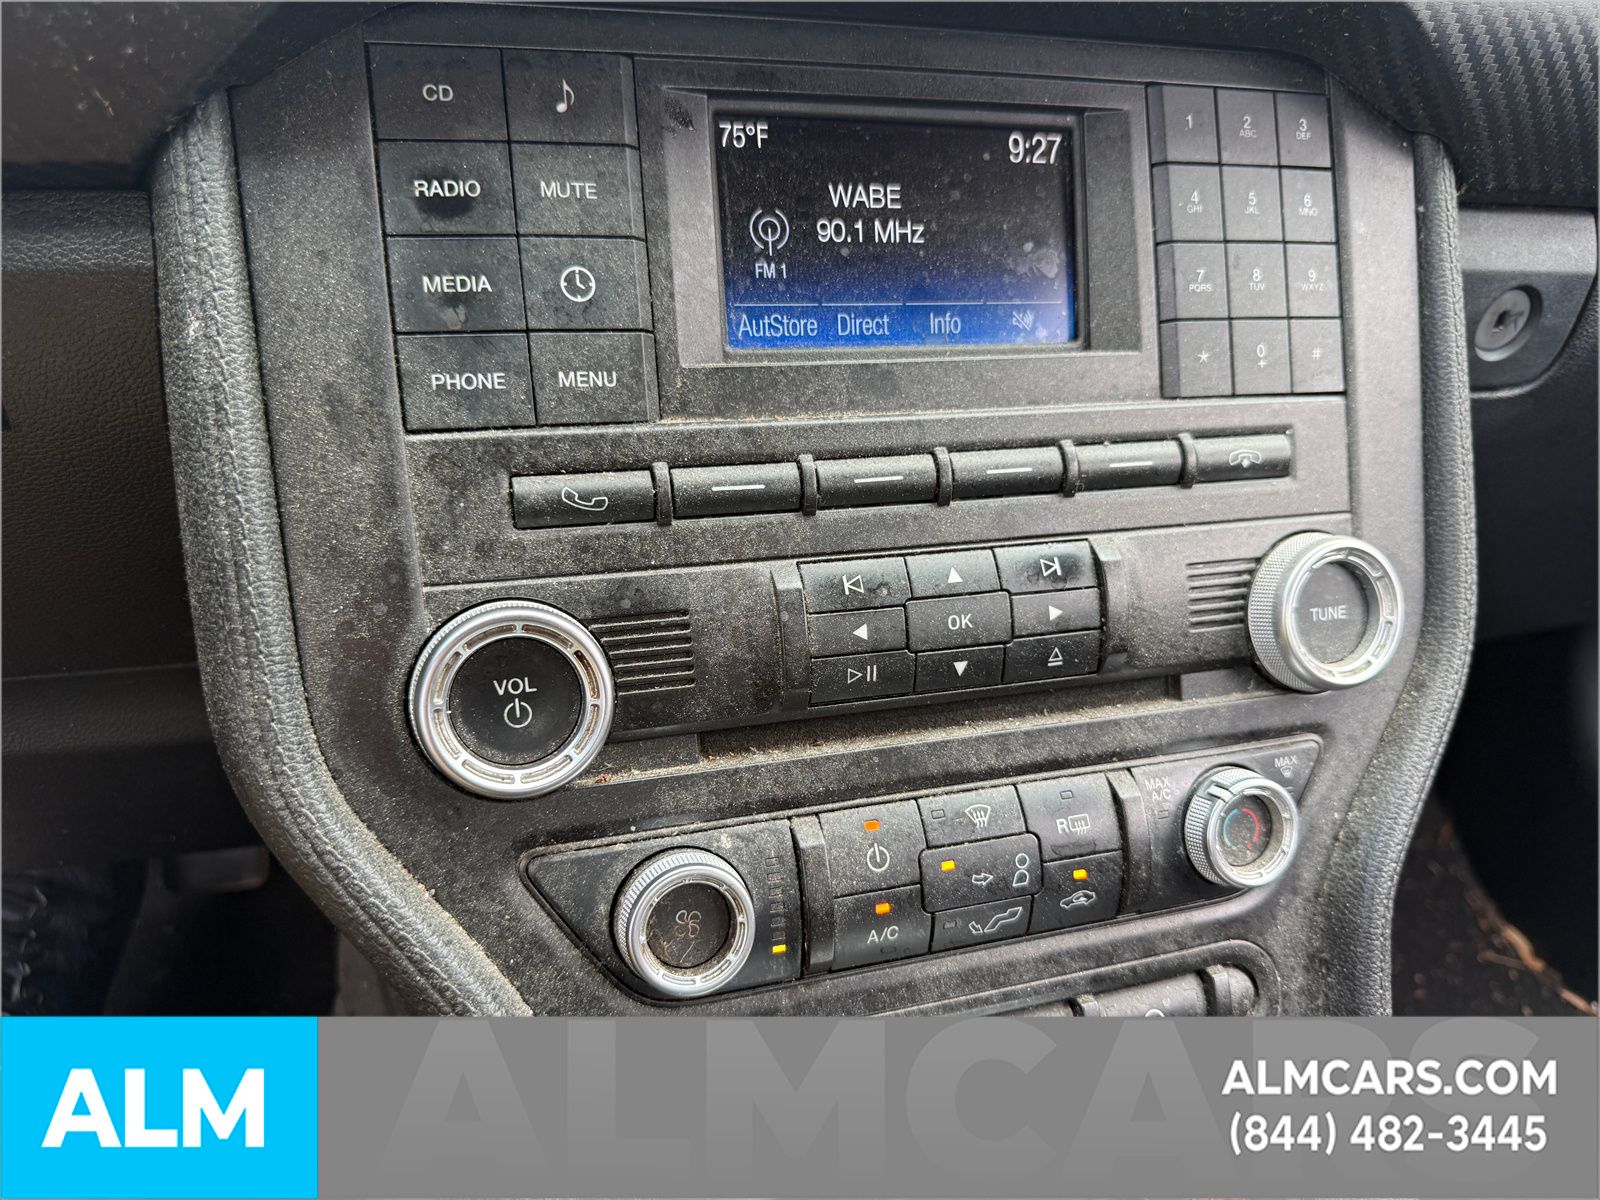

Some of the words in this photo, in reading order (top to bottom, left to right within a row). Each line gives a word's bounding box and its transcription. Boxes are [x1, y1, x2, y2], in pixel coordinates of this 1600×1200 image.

[422, 84, 454, 102] CD
[1186, 114, 1193, 129] 1
[1243, 116, 1251, 129] 2
[1299, 119, 1307, 132] 3
[1239, 130, 1257, 138] ABC
[1295, 132, 1312, 140] DEF
[1008, 130, 1062, 164] 9:27
[414, 180, 481, 198] RADIO
[540, 181, 597, 200] MUTE
[828, 182, 902, 209] WABE
[1190, 191, 1199, 204] 4
[1248, 193, 1257, 206] 5
[1303, 194, 1312, 208] 6
[1299, 208, 1318, 216] MNO
[816, 218, 865, 243] 90.1
[874, 221, 925, 244] MHz
[754, 263, 777, 278] FM
[780, 263, 787, 278] 1
[1196, 270, 1205, 283] 7
[1252, 269, 1261, 282] 8
[1308, 270, 1317, 283] 9
[422, 275, 492, 294] MEDIA
[1189, 284, 1212, 292] PQRS
[738, 315, 818, 337] AutStore
[837, 314, 890, 336] Direct
[929, 312, 962, 334] Info
[1256, 344, 1265, 357] 0
[431, 372, 506, 390] PHONE
[558, 371, 617, 388] MENU
[948, 613, 973, 630] OK
[1309, 605, 1348, 622] TUNE
[493, 677, 537, 696] VOL
[1274, 755, 1298, 769] MAX
[1144, 776, 1171, 792] MAX
[1151, 789, 1172, 802] A/C
[1056, 818, 1068, 834] R
[866, 926, 899, 944] A/C
